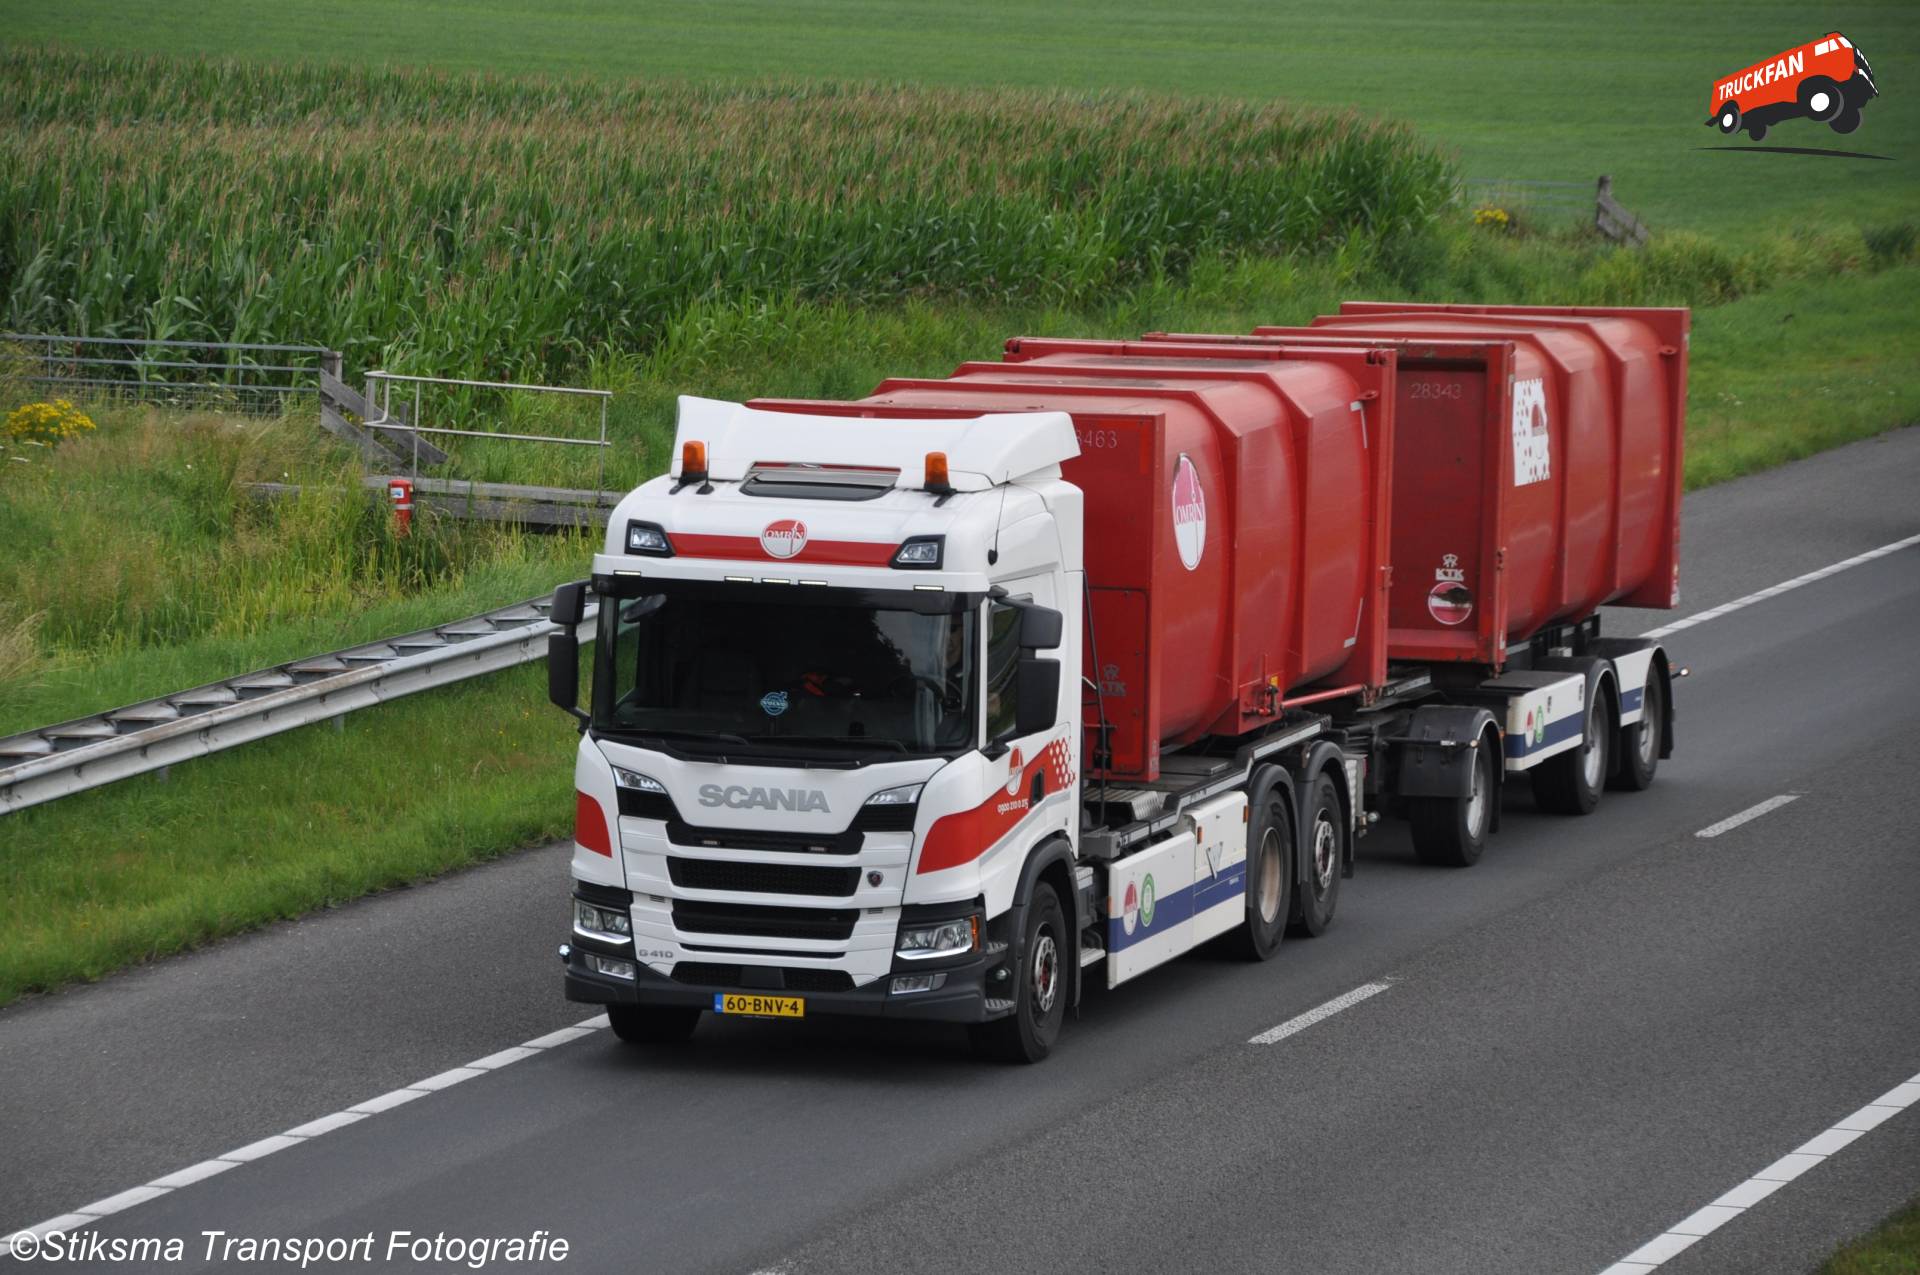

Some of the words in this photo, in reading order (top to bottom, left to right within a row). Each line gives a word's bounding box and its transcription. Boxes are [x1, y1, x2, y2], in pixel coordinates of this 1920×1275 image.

[1410, 383, 1461, 399] 28343
[765, 529, 805, 540] OMRIN
[1435, 568, 1464, 581] KTK
[698, 784, 831, 813] SCANIA
[726, 997, 799, 1014] 60-BNV-4
